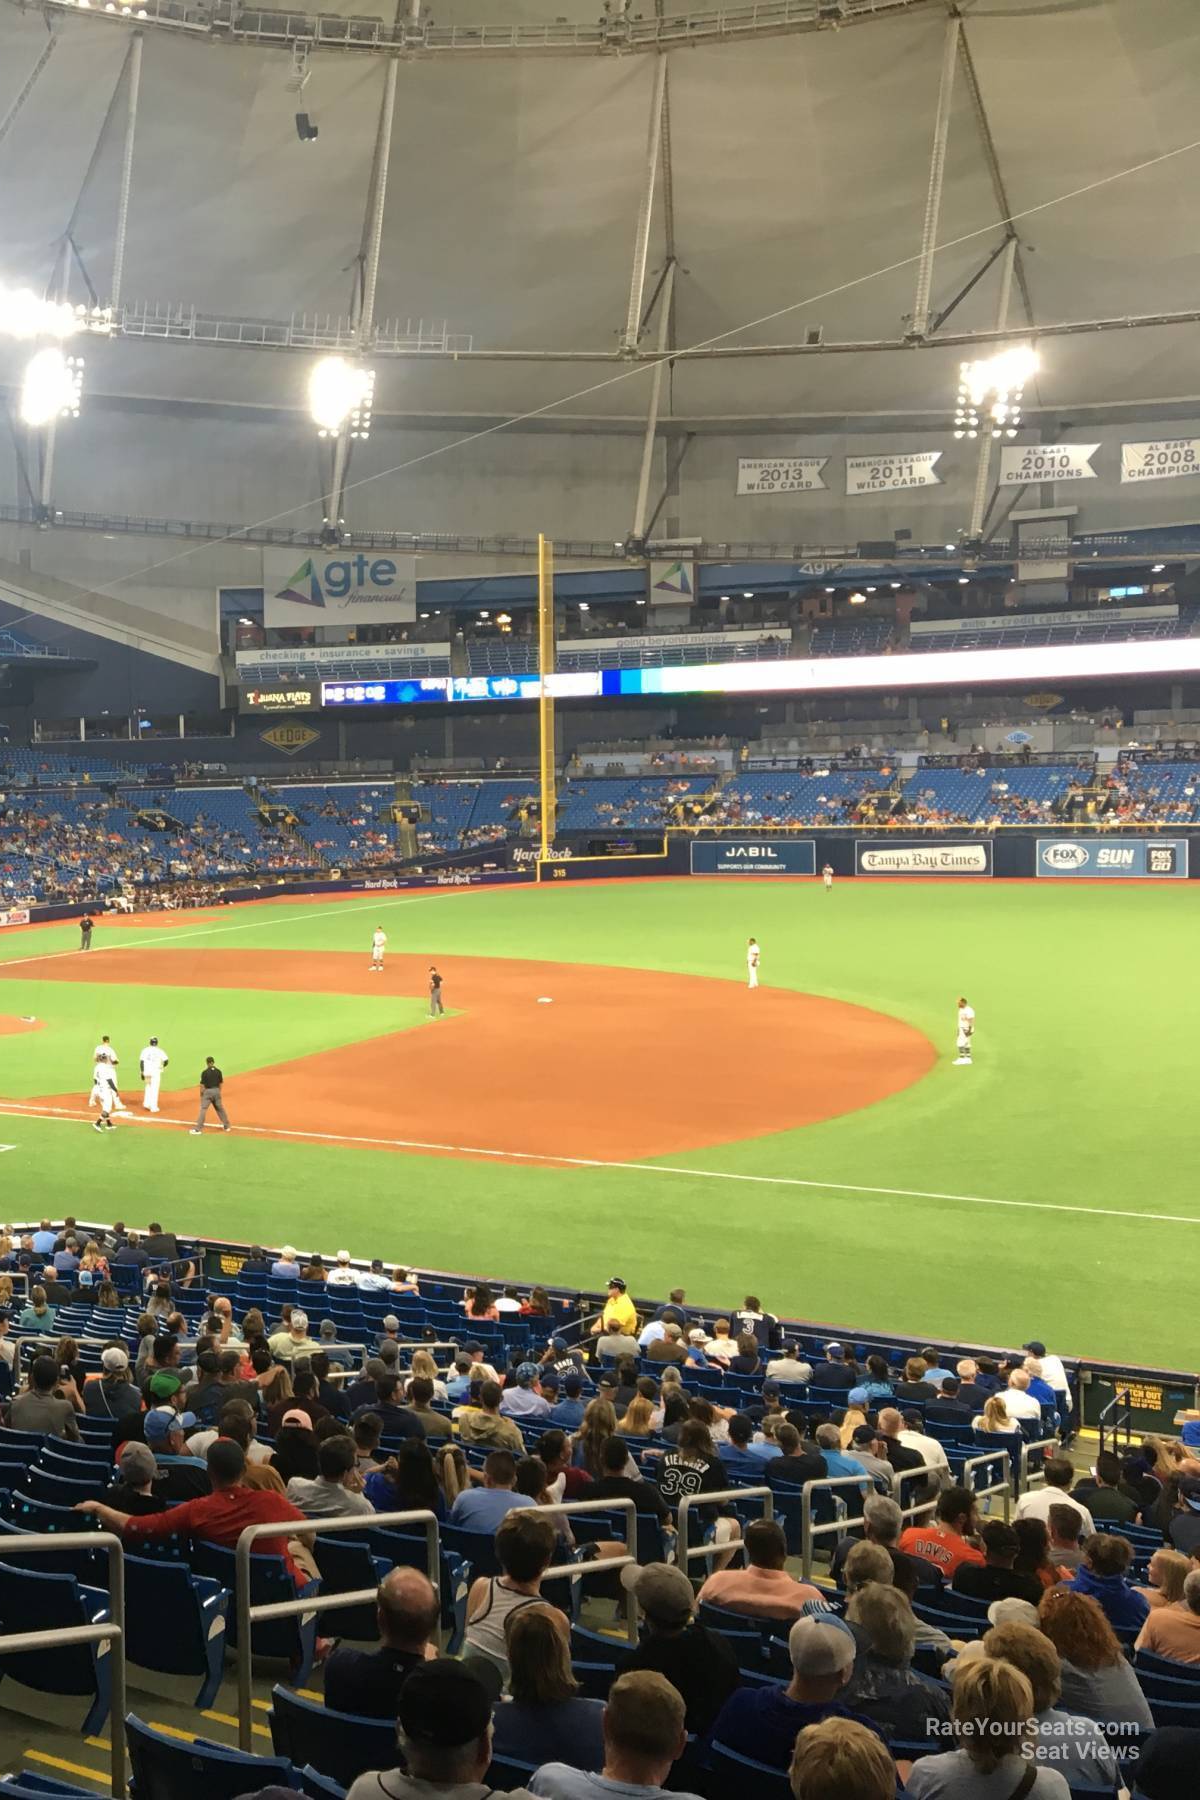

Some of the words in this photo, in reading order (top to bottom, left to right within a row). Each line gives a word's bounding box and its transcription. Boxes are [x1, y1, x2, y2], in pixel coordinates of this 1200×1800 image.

[741, 462, 785, 470] AMERICAN
[787, 460, 821, 468] LEAGUE
[849, 459, 895, 469] AMERICAN
[898, 455, 933, 464] LEAGUE
[1021, 455, 1071, 470] 2010
[1143, 449, 1196, 467] 2008
[759, 468, 803, 482] 2013
[869, 465, 915, 480] 2011
[1006, 469, 1083, 480] CHAMPIONS
[746, 482, 775, 491] WILD
[780, 480, 813, 489] CARD
[856, 480, 887, 490] WILD
[892, 476, 926, 487] CARD
[324, 553, 397, 598] gte
[1002, 615, 1036, 626] credit
[617, 639, 646, 648] going
[650, 636, 689, 647] beyond
[691, 634, 727, 644] money
[259, 650, 307, 661] checking
[319, 648, 371, 658] insurance
[384, 645, 426, 656] savings
[272, 729, 308, 743] LEDGE
[513, 847, 542, 863] Hard
[725, 847, 778, 857] JABIL
[1052, 849, 1077, 859] FOX
[1097, 848, 1135, 864] SUN
[867, 854, 910, 869] Tampa
[912, 853, 938, 868] Bay
[940, 852, 981, 866] Times
[1151, 862, 1172, 871] GO
[438, 875, 455, 884] Hard
[455, 874, 471, 884] Rock
[552, 868, 567, 878] 315
[364, 879, 382, 889] Hard
[382, 879, 399, 889] Rock
[742, 1318, 755, 1335] 3
[1146, 1390, 1163, 1400] OUT
[660, 1468, 703, 1497] 39
[914, 1539, 954, 1564] DAVIS
